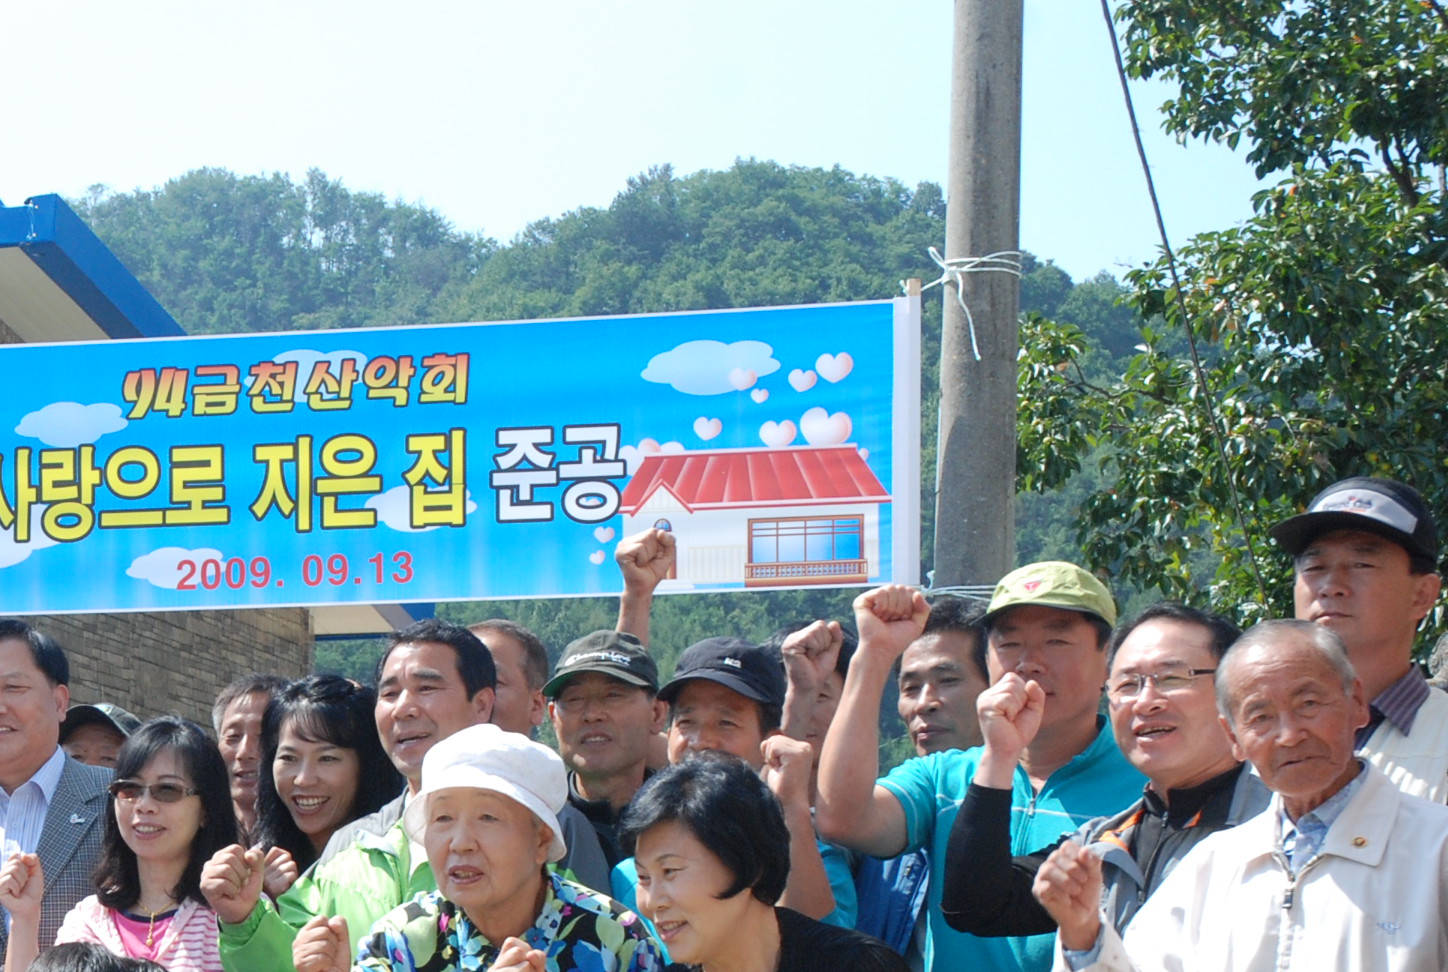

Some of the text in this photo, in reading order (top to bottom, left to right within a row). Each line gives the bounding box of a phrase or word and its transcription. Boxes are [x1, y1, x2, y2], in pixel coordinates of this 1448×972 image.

[123, 353, 470, 420] 94금천산악회
[250, 433, 382, 533] 지은
[403, 427, 468, 527] 집
[490, 423, 627, 524] 준공
[176, 557, 284, 591] 2009.
